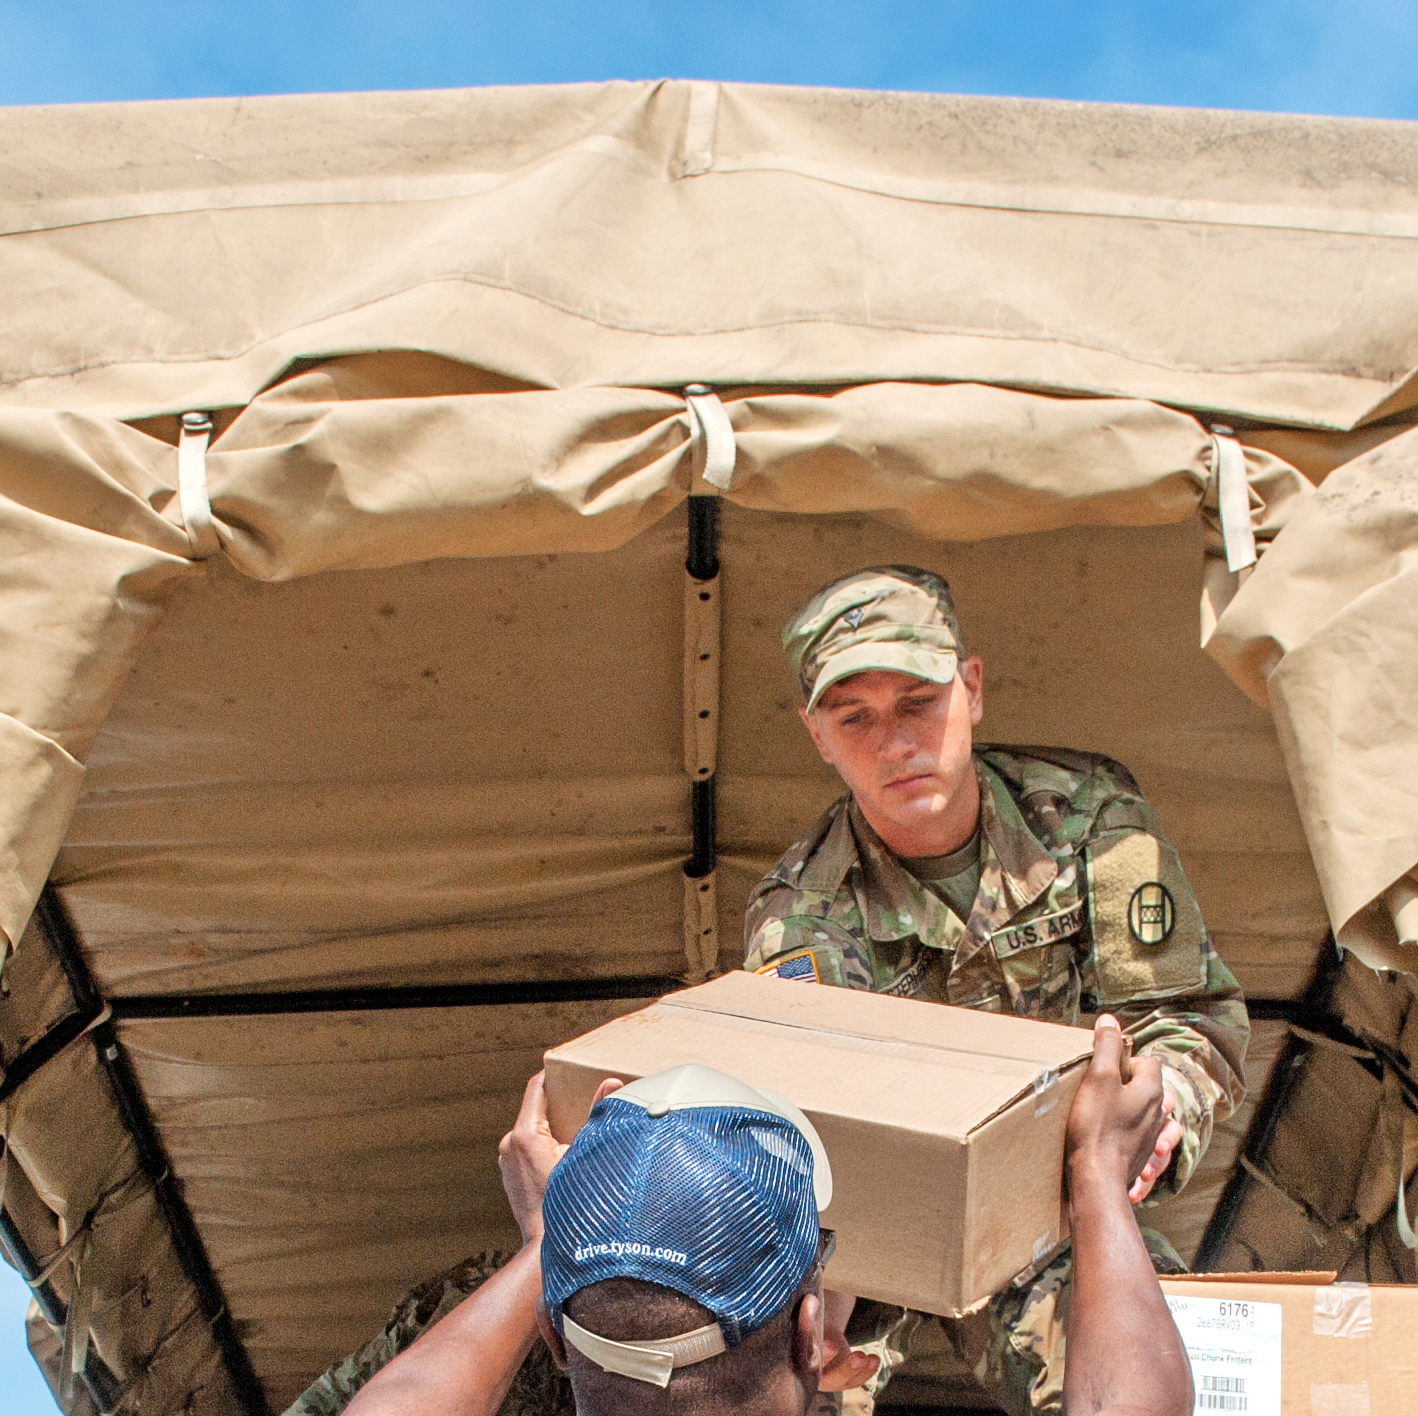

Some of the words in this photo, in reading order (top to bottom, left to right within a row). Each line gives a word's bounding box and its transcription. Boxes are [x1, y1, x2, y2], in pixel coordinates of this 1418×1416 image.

[1006, 928, 1044, 951] U.S.
[574, 1240, 688, 1266] drive.tyson.com
[1219, 1302, 1249, 1318] 6176
